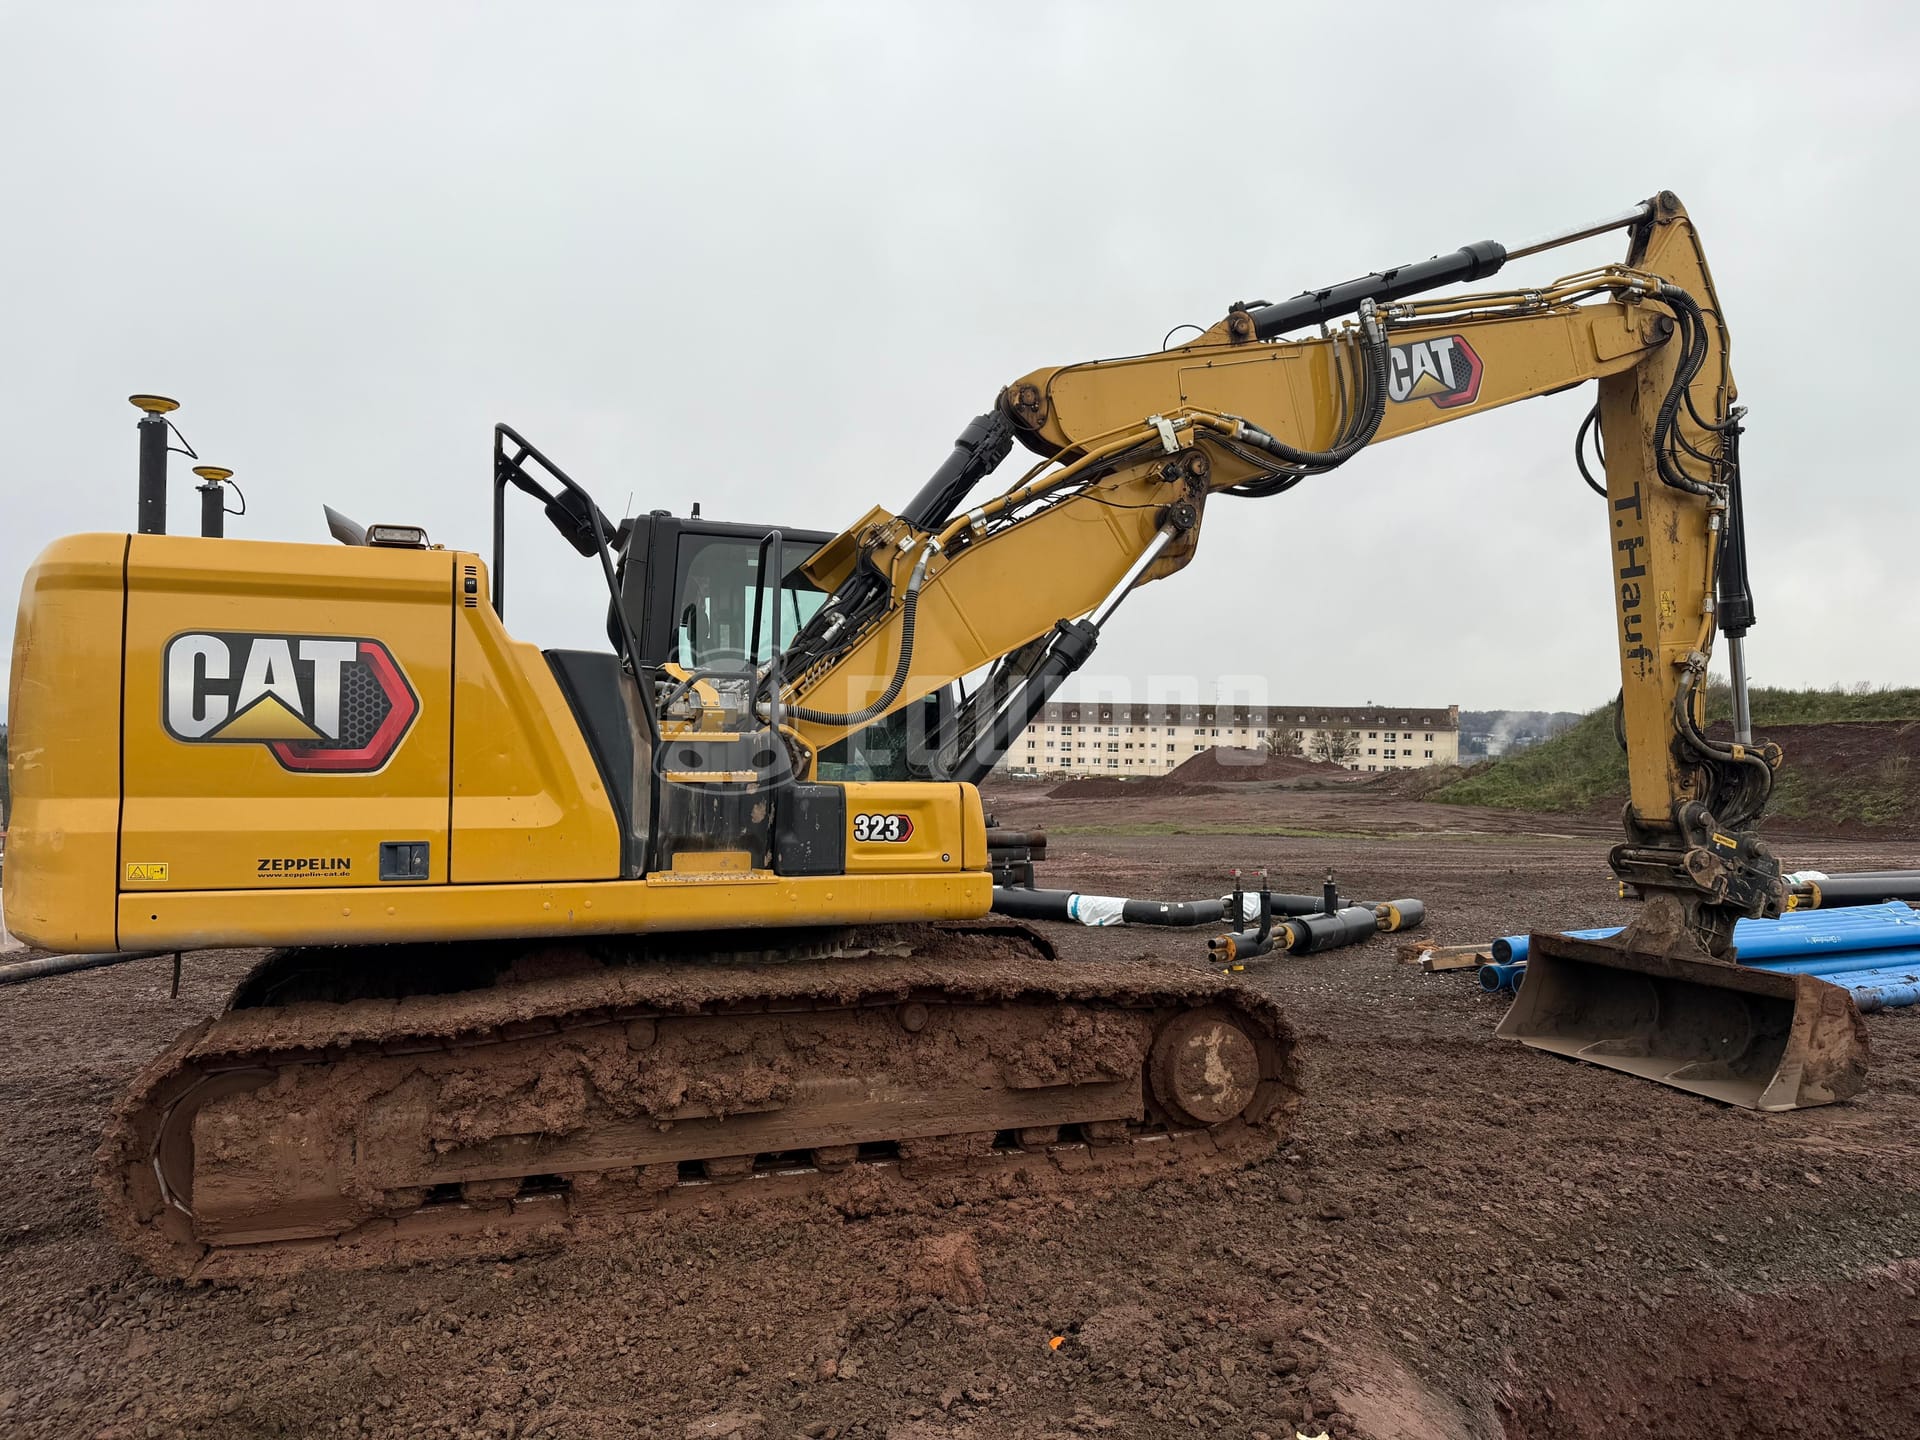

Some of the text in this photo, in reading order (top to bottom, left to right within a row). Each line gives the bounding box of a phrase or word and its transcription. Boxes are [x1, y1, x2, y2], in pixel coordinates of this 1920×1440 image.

[1389, 337, 1457, 402] CAT
[168, 634, 357, 740] CAT
[854, 814, 900, 841] 323
[257, 858, 351, 871] ZEPPELIN
[257, 871, 351, 879] www.zeppelin-cat.de
